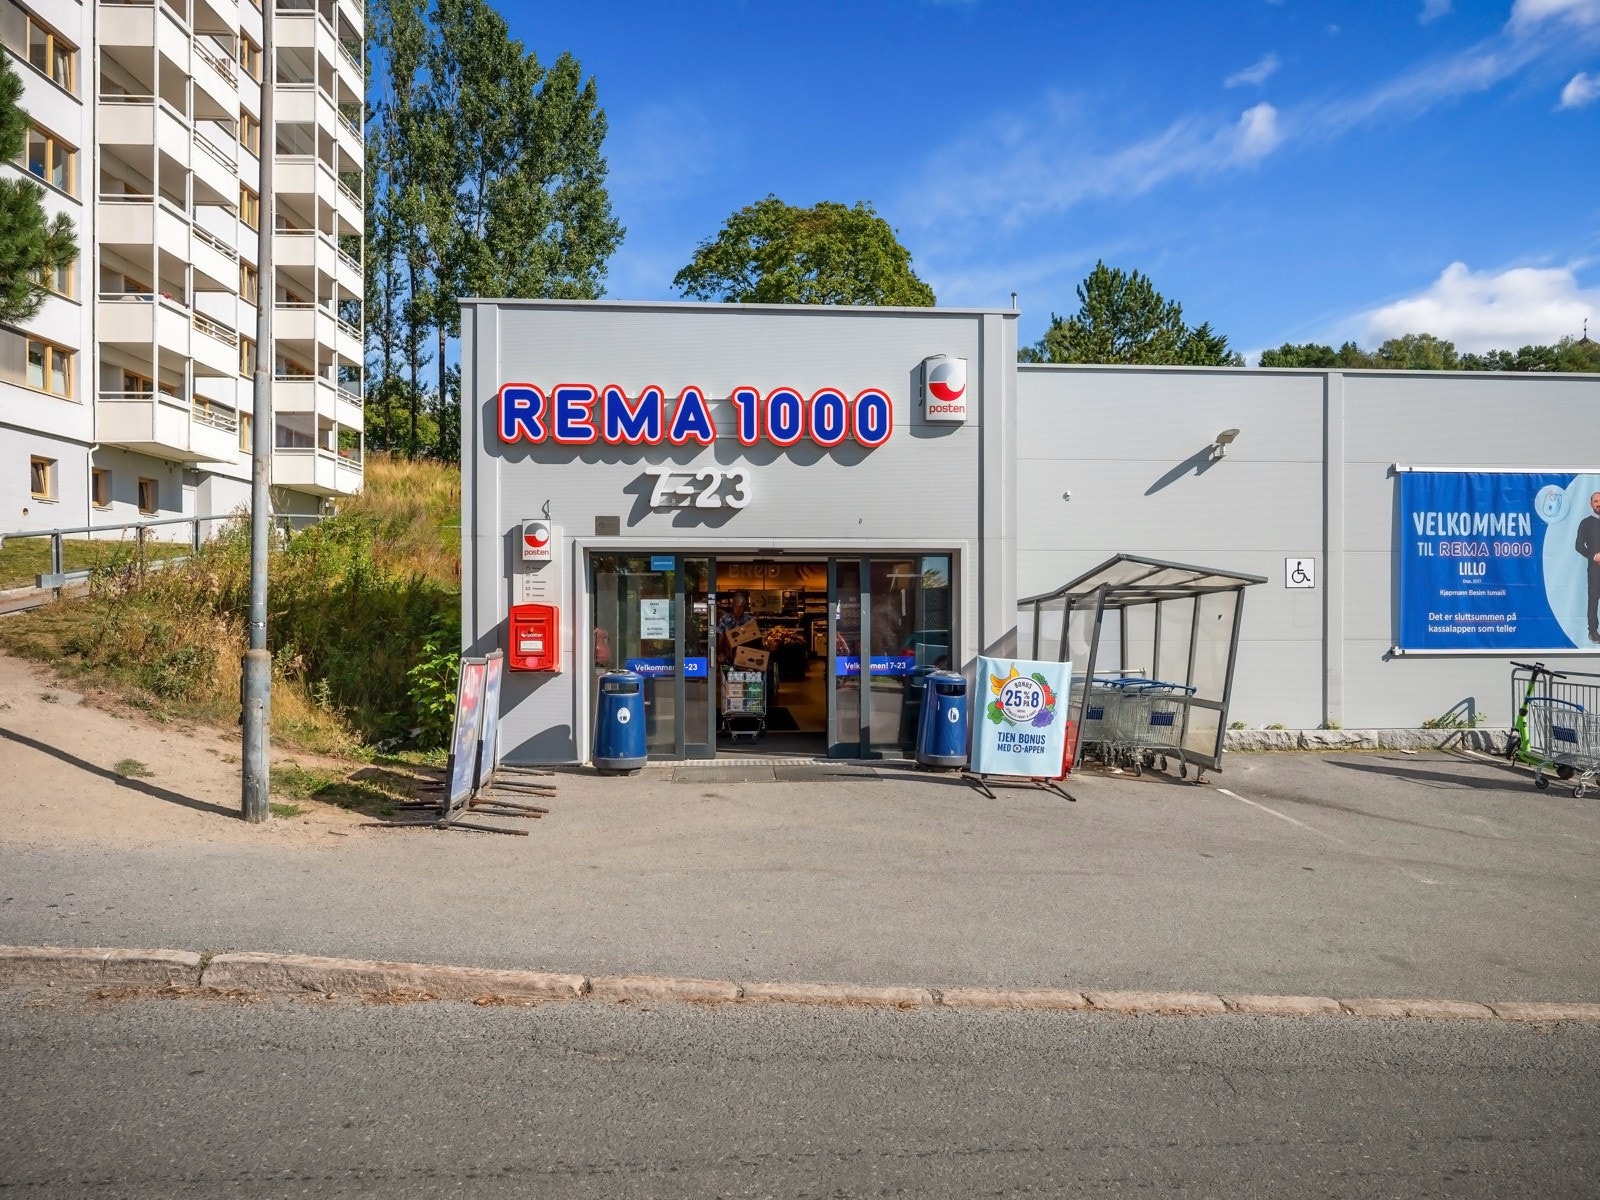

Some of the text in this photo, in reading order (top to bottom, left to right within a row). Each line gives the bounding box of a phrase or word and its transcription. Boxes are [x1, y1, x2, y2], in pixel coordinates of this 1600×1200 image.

[498, 383, 893, 447] REMA 1000
[929, 403, 965, 415] posten
[645, 467, 753, 508] 7-23
[1412, 511, 1532, 537] VELKOMMEN
[524, 548, 549, 556] posten
[1417, 541, 1533, 557] TIL REMA 1000
[1459, 562, 1486, 576] LILLO
[1439, 589, 1468, 597] Kjøpmann
[1428, 612, 1444, 621] Det
[1454, 612, 1505, 622] sluttsummen
[1506, 612, 1517, 624] på
[1428, 624, 1476, 634] kassalappen
[1496, 624, 1517, 633] teller
[683, 663, 698, 671] -23
[1014, 681, 1033, 690] BONUS
[1005, 689, 1022, 707] 25
[1031, 691, 1040, 708] 8
[997, 732, 1046, 745] TJEN BONUS
[997, 743, 1011, 752] MED
